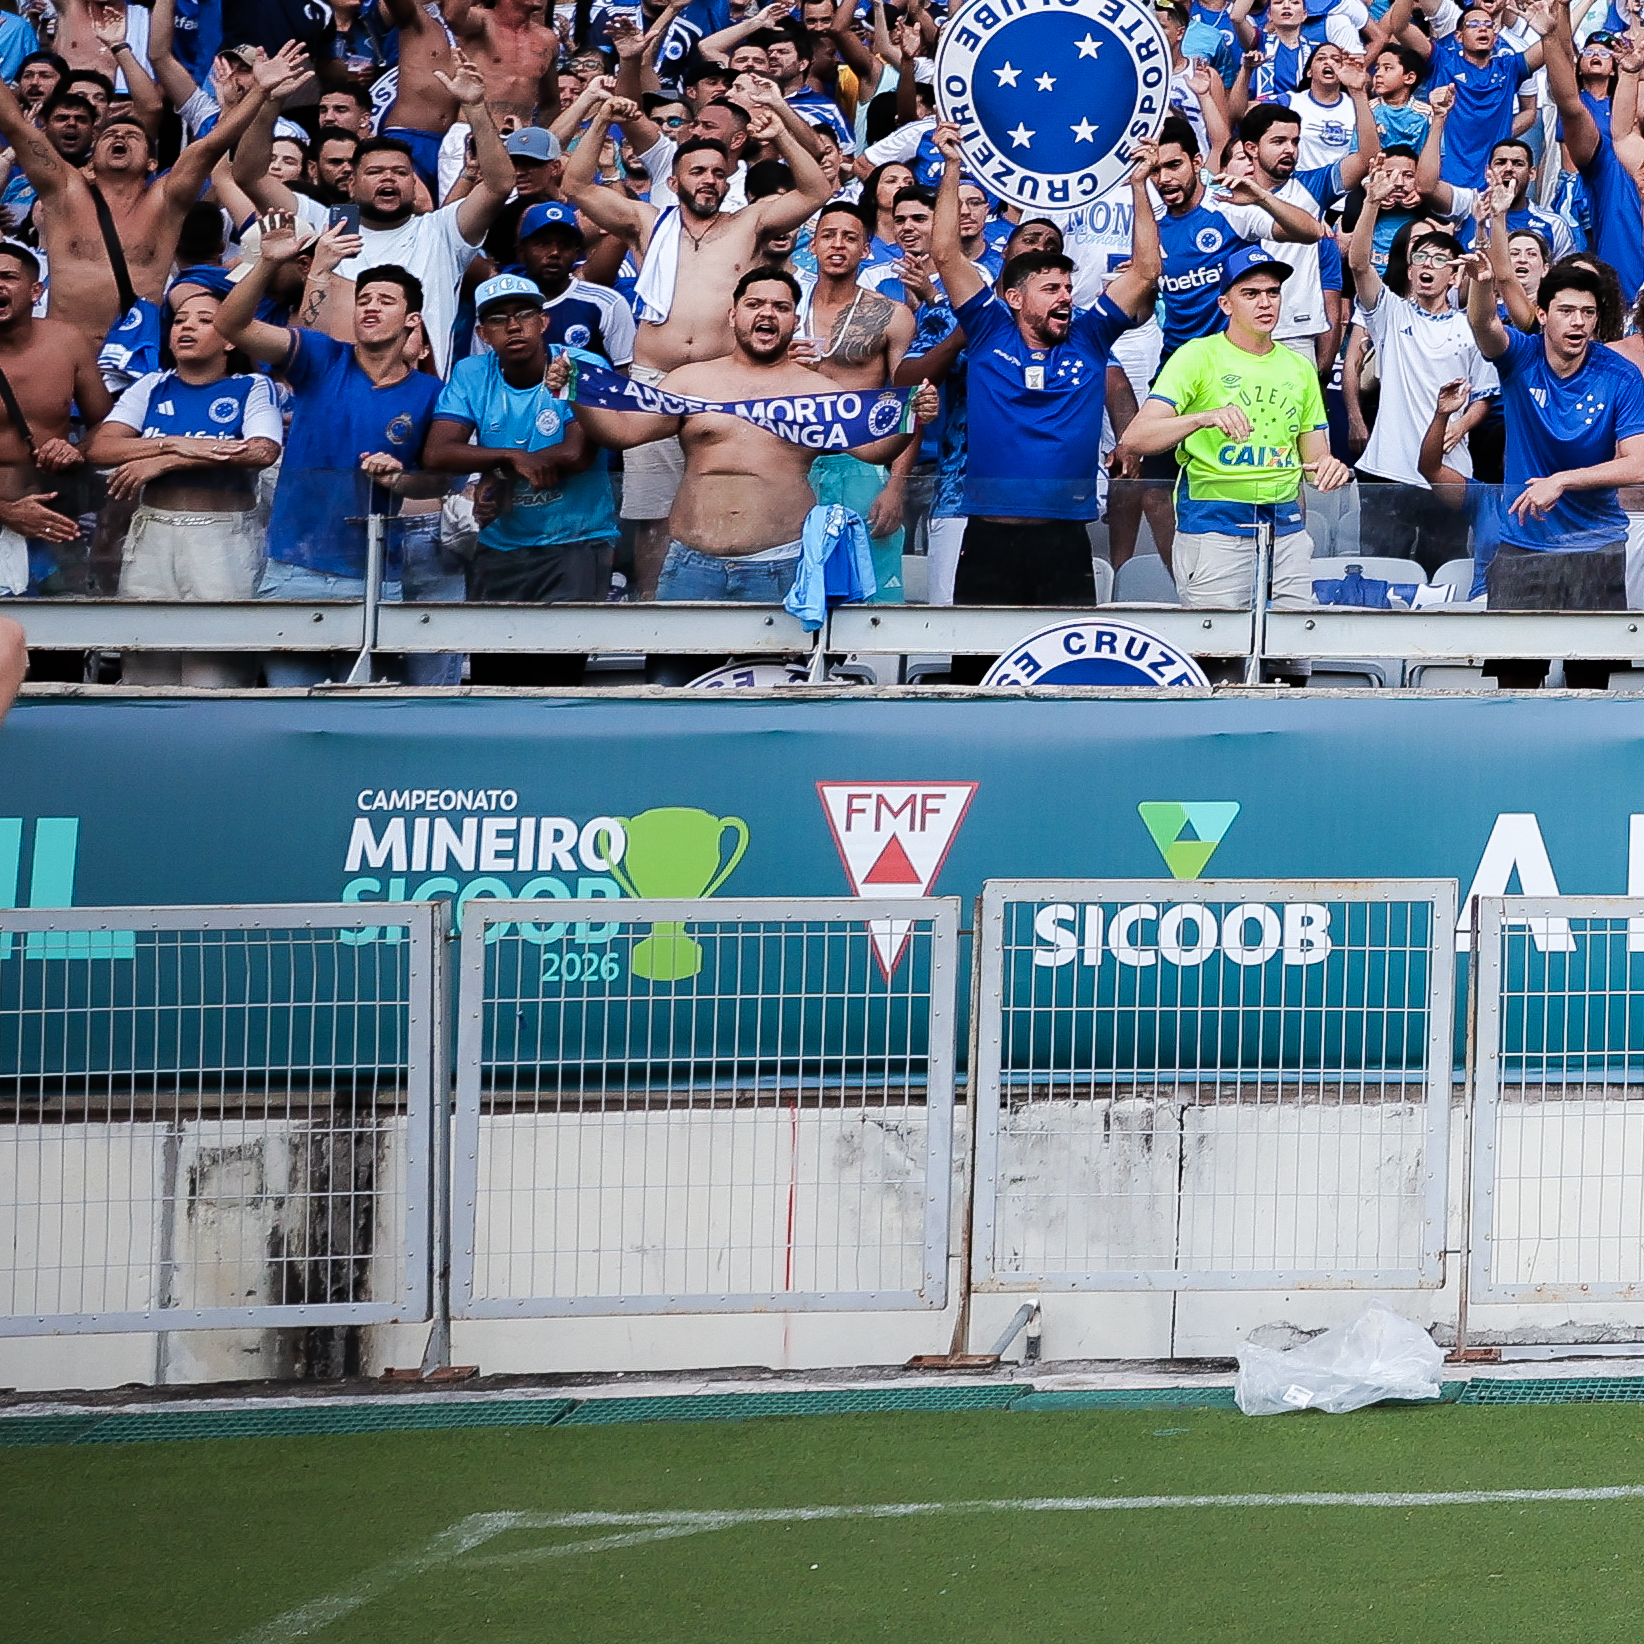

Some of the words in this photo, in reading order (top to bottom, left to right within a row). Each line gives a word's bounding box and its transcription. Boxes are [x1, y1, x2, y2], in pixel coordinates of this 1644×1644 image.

[945, 74, 1099, 203] CRUZEIRO
[735, 392, 862, 423] MORTO
[1237, 385, 1300, 433] UZEIRO
[1217, 444, 1298, 468] CAIXA
[356, 788, 519, 812] CAMPEONATO
[844, 793, 947, 833] FMF
[344, 816, 628, 873] MINEIRO
[1454, 812, 1577, 953] A
[1032, 902, 1335, 968] SICOOB
[541, 953, 620, 983] 2026
